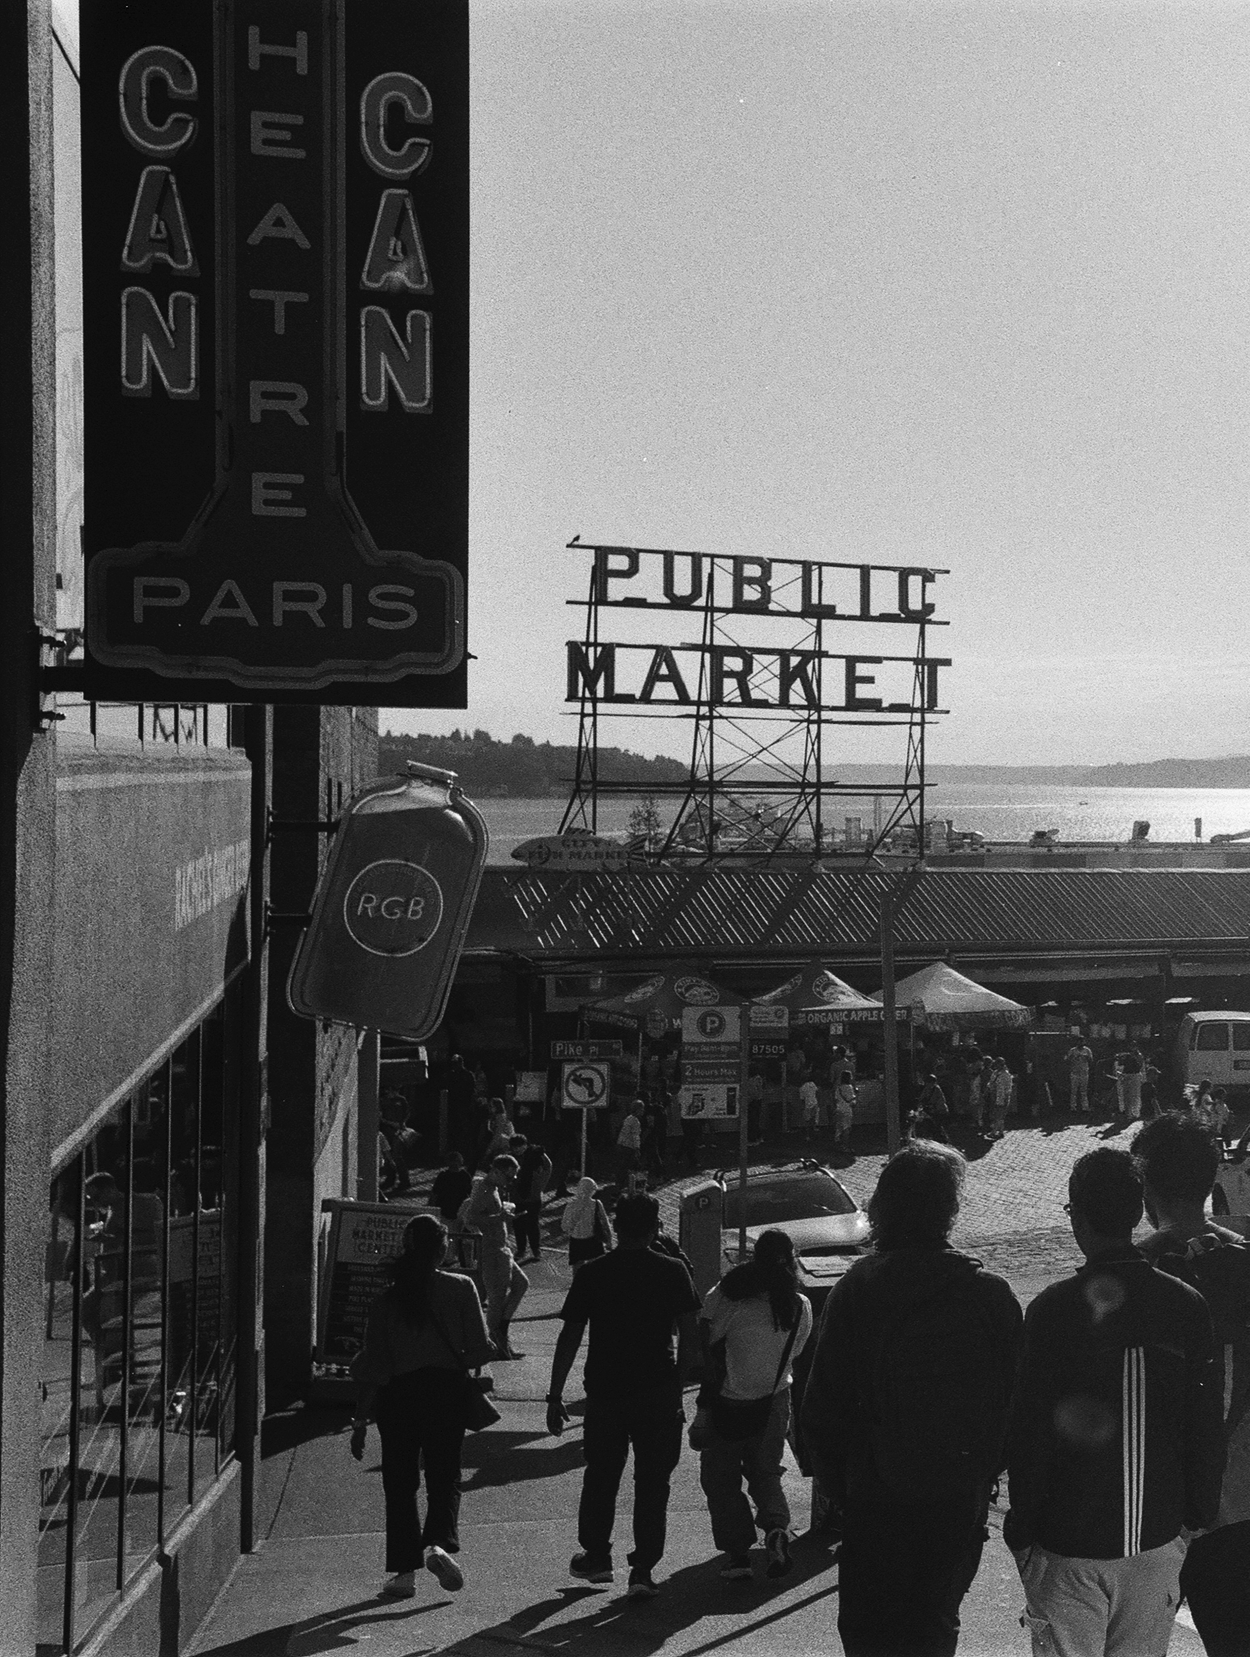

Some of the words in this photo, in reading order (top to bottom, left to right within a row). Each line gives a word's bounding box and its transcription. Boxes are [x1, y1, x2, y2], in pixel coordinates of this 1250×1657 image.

[118, 44, 201, 399] CAN
[359, 70, 435, 415] CAN
[246, 24, 312, 517] HEATRE
[595, 546, 936, 620] PUBLIC
[133, 576, 419, 631] PARIS
[566, 640, 952, 711] MARKET
[356, 891, 426, 921] RGB
[705, 1015, 720, 1033] P
[807, 1010, 849, 1024] ORGANIC
[850, 1010, 880, 1022] APPLE
[880, 1009, 908, 1021] CER
[555, 1043, 583, 1056] Pike
[751, 1044, 786, 1055] 87505
[685, 1064, 693, 1076] 2
[693, 1067, 719, 1076] Hours
[720, 1067, 738, 1076] Max
[352, 1228, 398, 1242] MARKET
